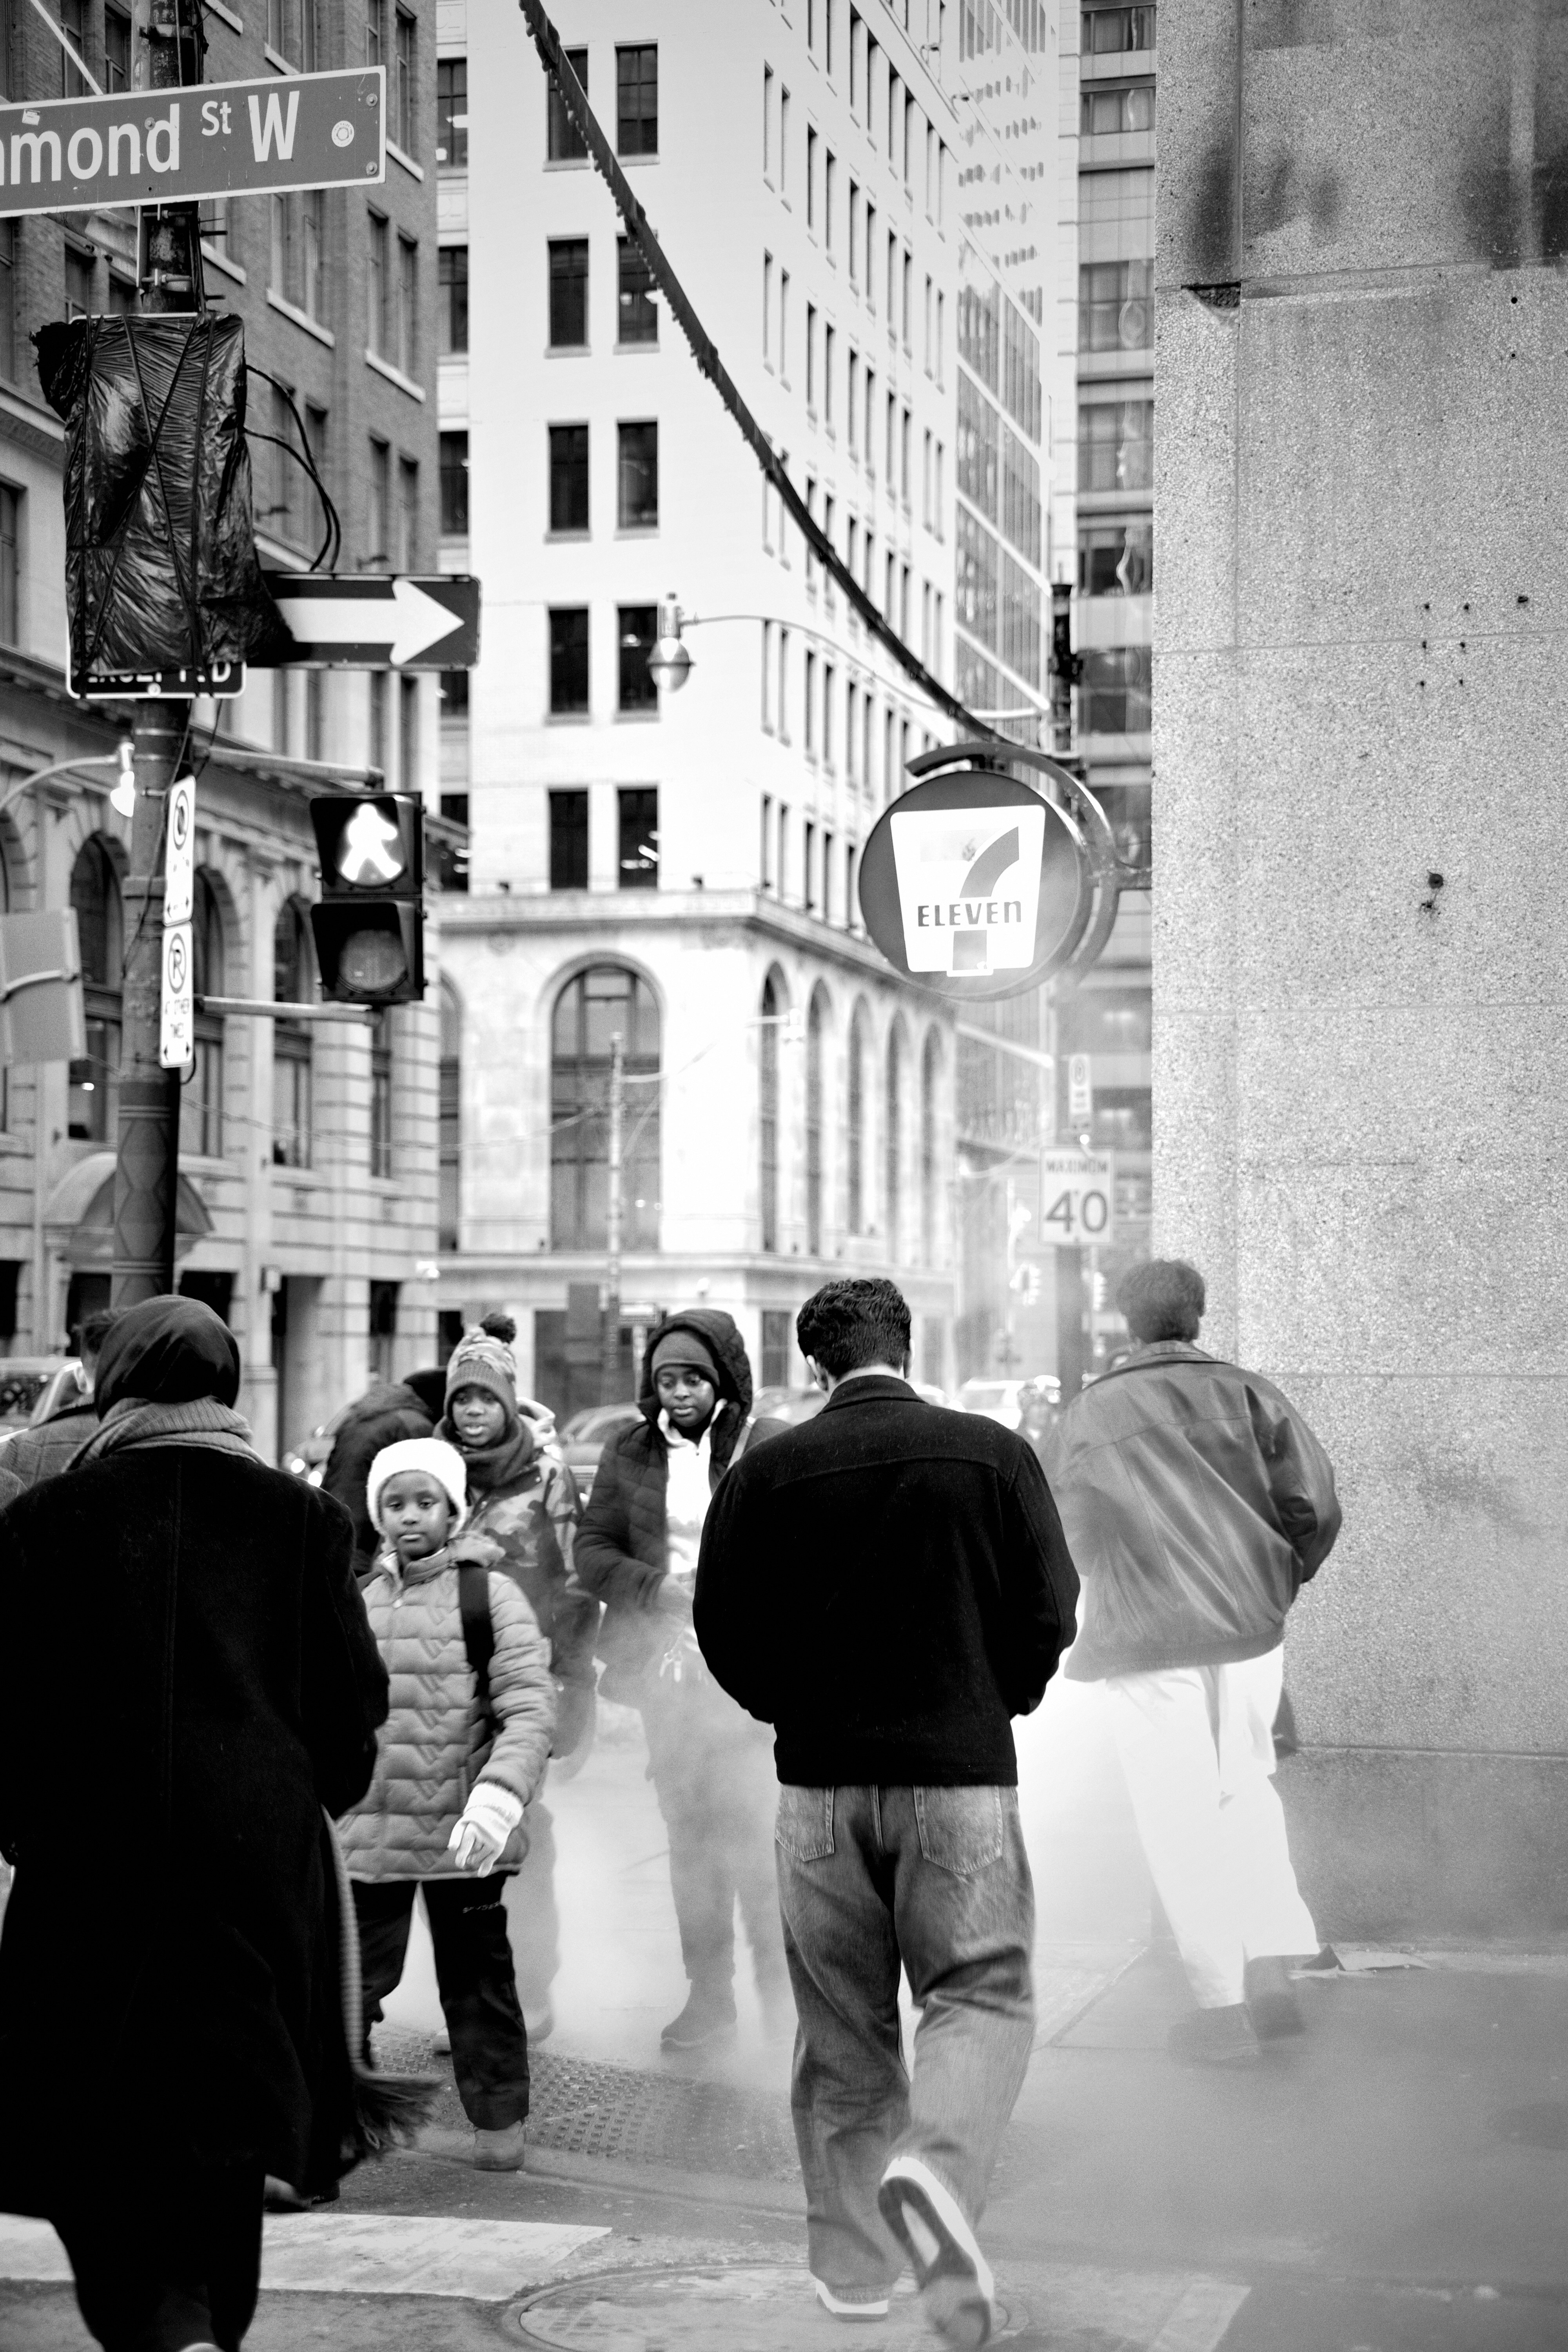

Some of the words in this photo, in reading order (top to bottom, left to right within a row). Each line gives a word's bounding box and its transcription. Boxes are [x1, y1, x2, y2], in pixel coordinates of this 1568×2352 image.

[0, 103, 180, 186] mond
[201, 100, 232, 136] St
[248, 91, 300, 163] W
[920, 826, 1020, 971] 7
[1046, 1158, 1108, 1174] MAXIMUM
[1044, 1189, 1109, 1234] 40
